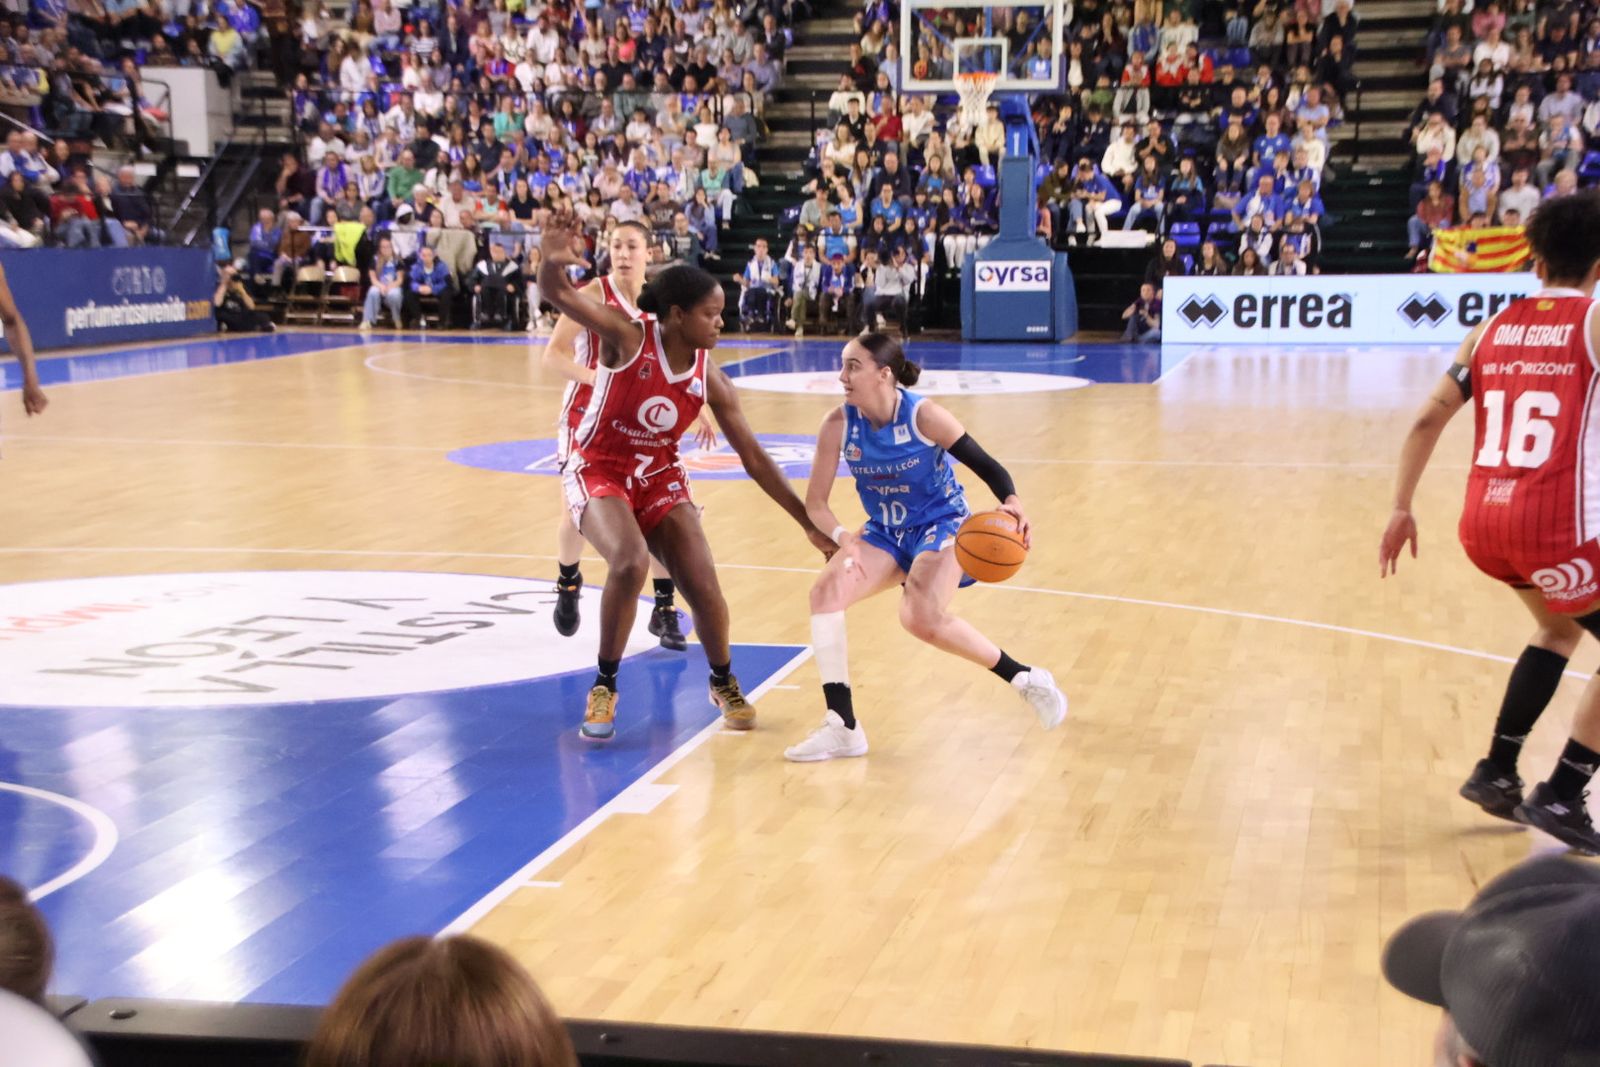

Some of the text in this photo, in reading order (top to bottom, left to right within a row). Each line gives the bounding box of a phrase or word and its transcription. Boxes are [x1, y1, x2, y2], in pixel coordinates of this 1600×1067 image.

[1524, 323, 1575, 347] GIRALT
[1499, 360, 1576, 376] HORIZONT
[1475, 390, 1561, 468] 16
[634, 452, 655, 478] 7
[886, 463, 893, 474] Y
[895, 457, 920, 471] LEÓN
[879, 500, 908, 526] 10
